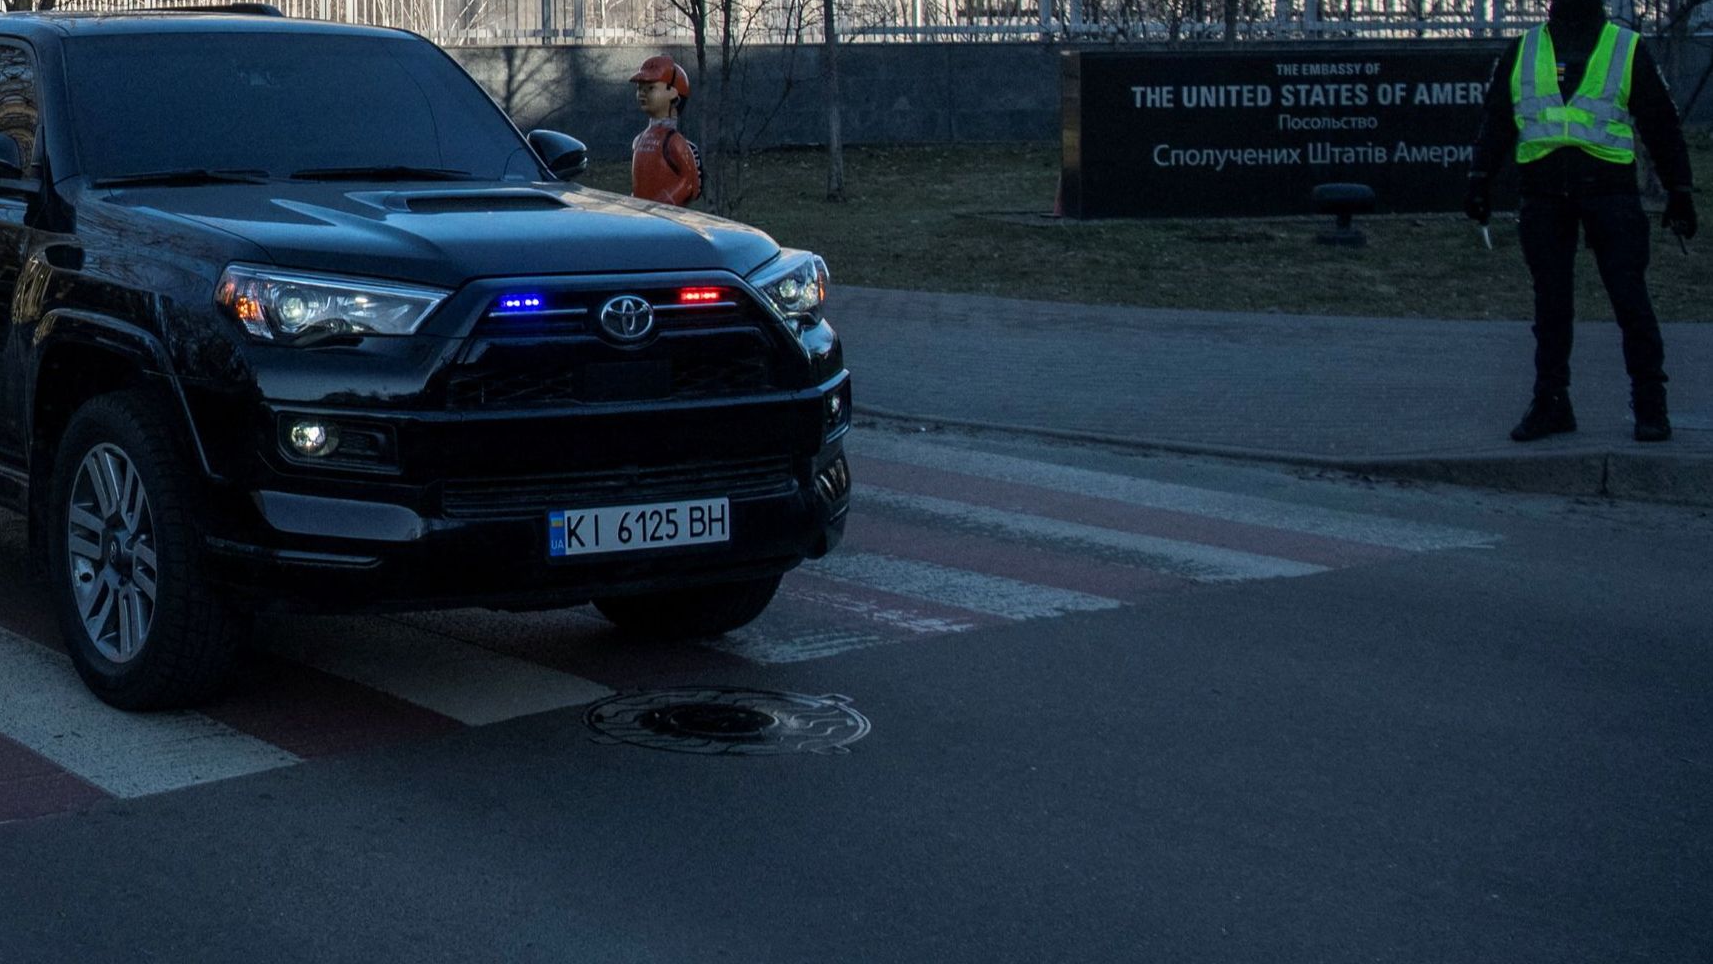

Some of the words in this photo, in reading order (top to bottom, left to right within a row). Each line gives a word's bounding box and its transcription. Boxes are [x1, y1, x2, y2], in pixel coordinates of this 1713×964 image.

[1276, 63, 1298, 76] THE
[1302, 63, 1361, 76] EMBASSY
[1365, 62, 1381, 75] OF
[1131, 86, 1174, 108] THE
[1183, 85, 1272, 108] UNITED
[1281, 83, 1369, 107] STATES
[1378, 83, 1406, 105] OF
[1279, 113, 1378, 130] Посольство
[1153, 144, 1301, 170] Сполучених
[1308, 141, 1387, 164] Штатів
[566, 515, 600, 548] KI
[617, 507, 679, 545] 6125
[689, 504, 725, 538] BH
[551, 539, 564, 550] UA
